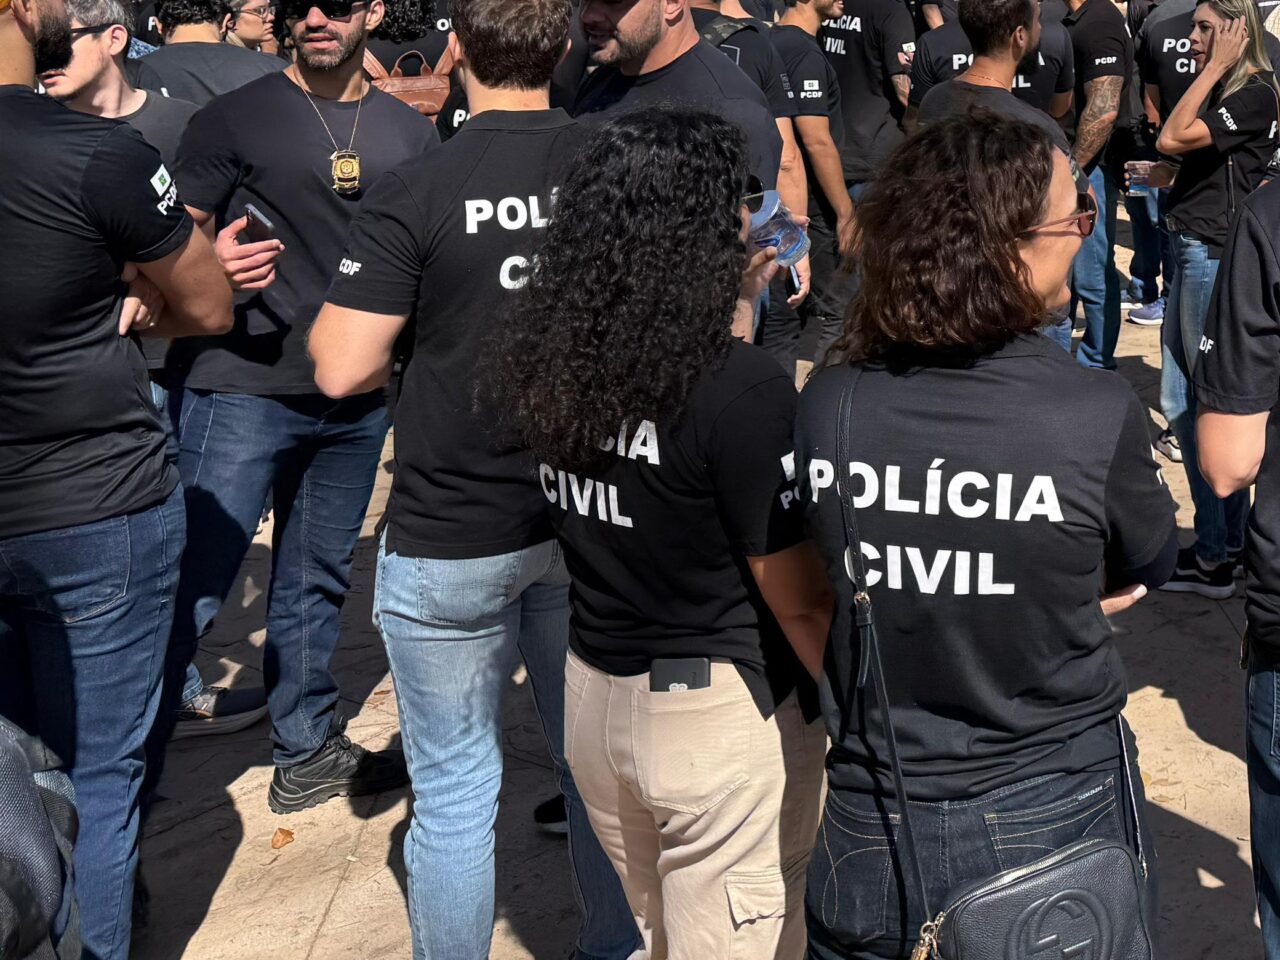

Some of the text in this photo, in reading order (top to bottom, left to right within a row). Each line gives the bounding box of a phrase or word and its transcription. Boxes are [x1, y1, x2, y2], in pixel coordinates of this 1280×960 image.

[823, 37, 847, 55] IVIL
[1095, 56, 1118, 65] PCDF
[800, 91, 823, 99] PCDF
[1218, 107, 1238, 132] PCDF
[339, 257, 362, 276] CDF
[1199, 334, 1215, 355] DF
[539, 462, 634, 528] CIVIL
[809, 458, 1065, 522] POLÍCIA
[844, 541, 1016, 595] CIVIL
